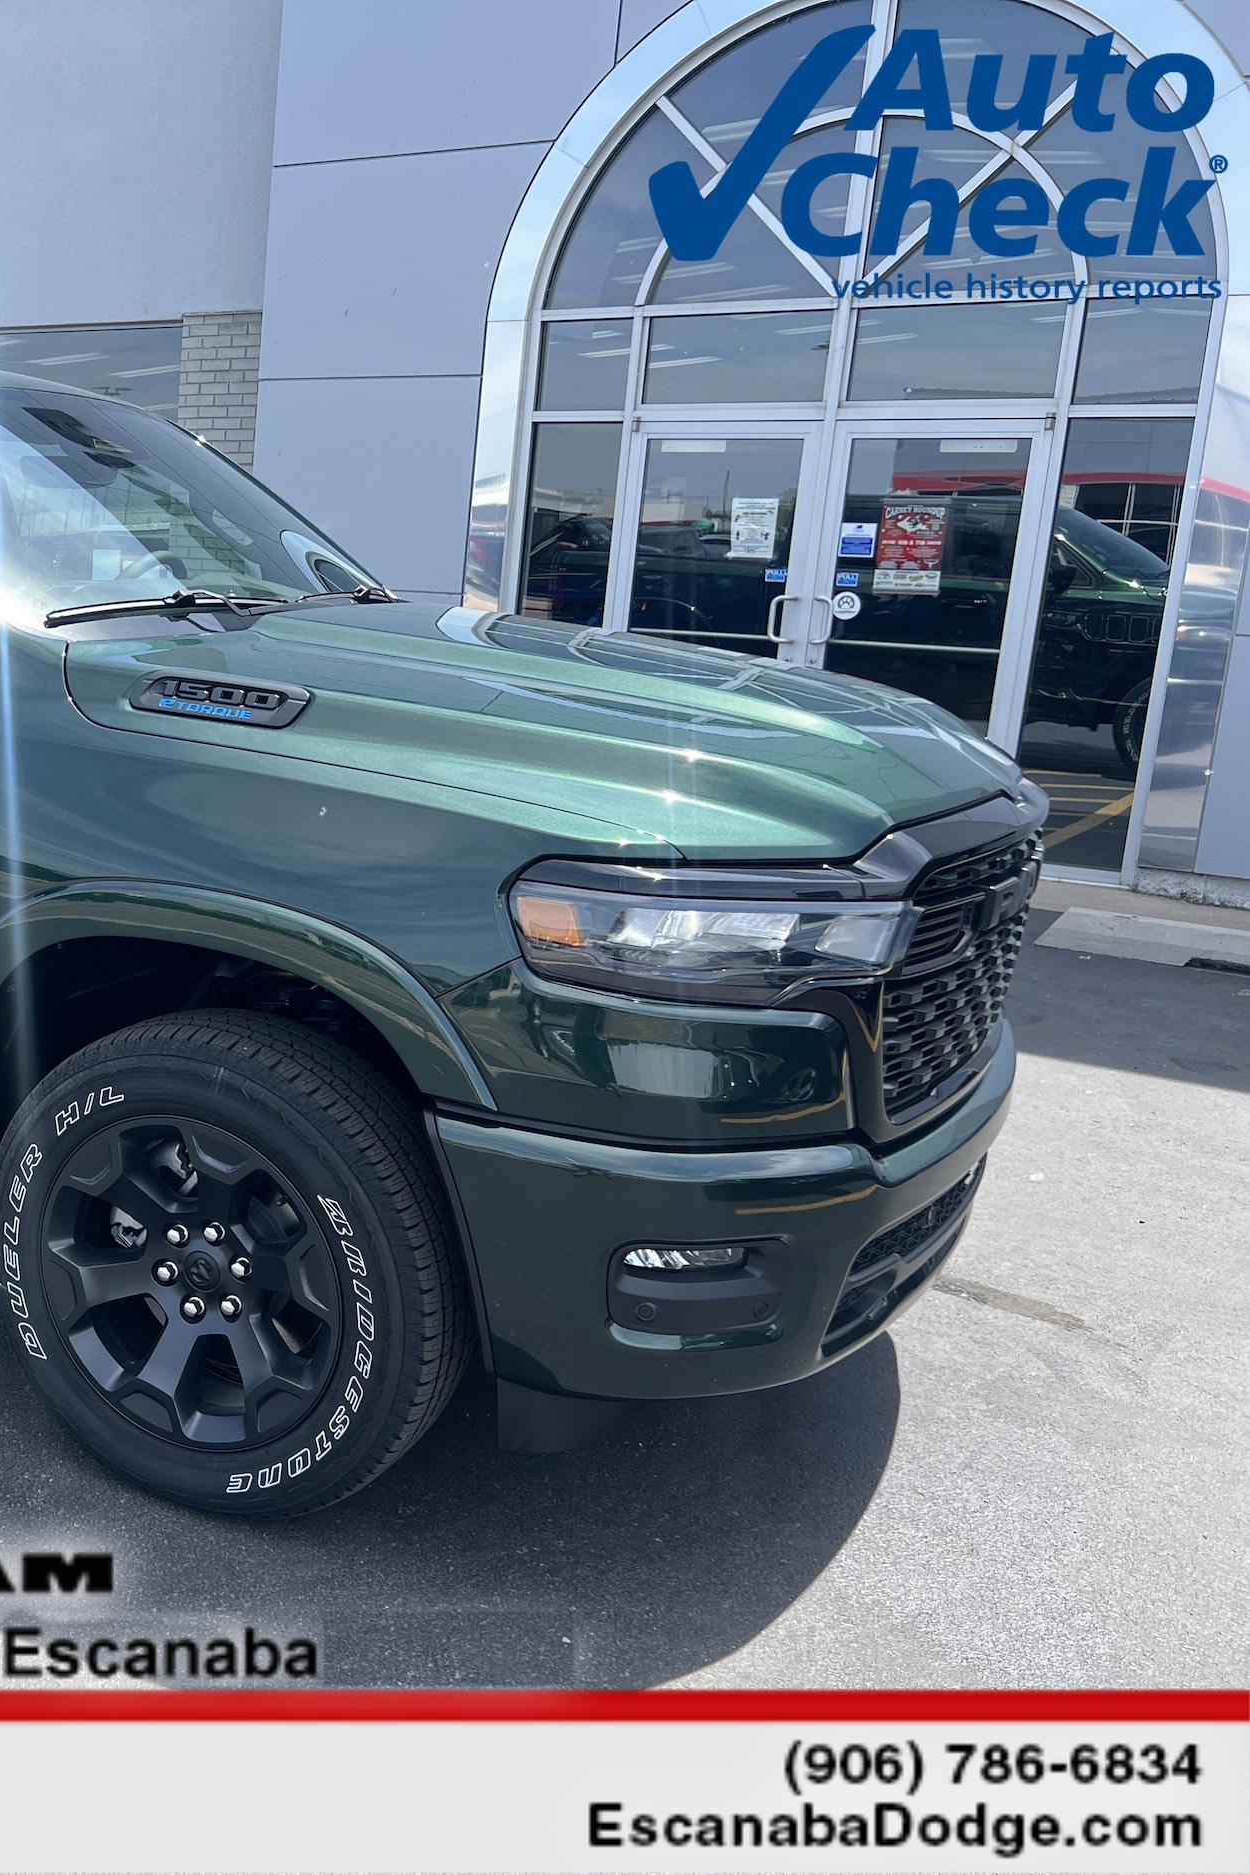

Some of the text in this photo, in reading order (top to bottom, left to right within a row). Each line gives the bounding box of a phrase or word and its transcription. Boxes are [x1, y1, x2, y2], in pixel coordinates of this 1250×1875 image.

[162, 680, 280, 709] 1500
[1, 1086, 125, 1360] DUELER H/L
[226, 1195, 376, 1493] BRIDGESTONE
